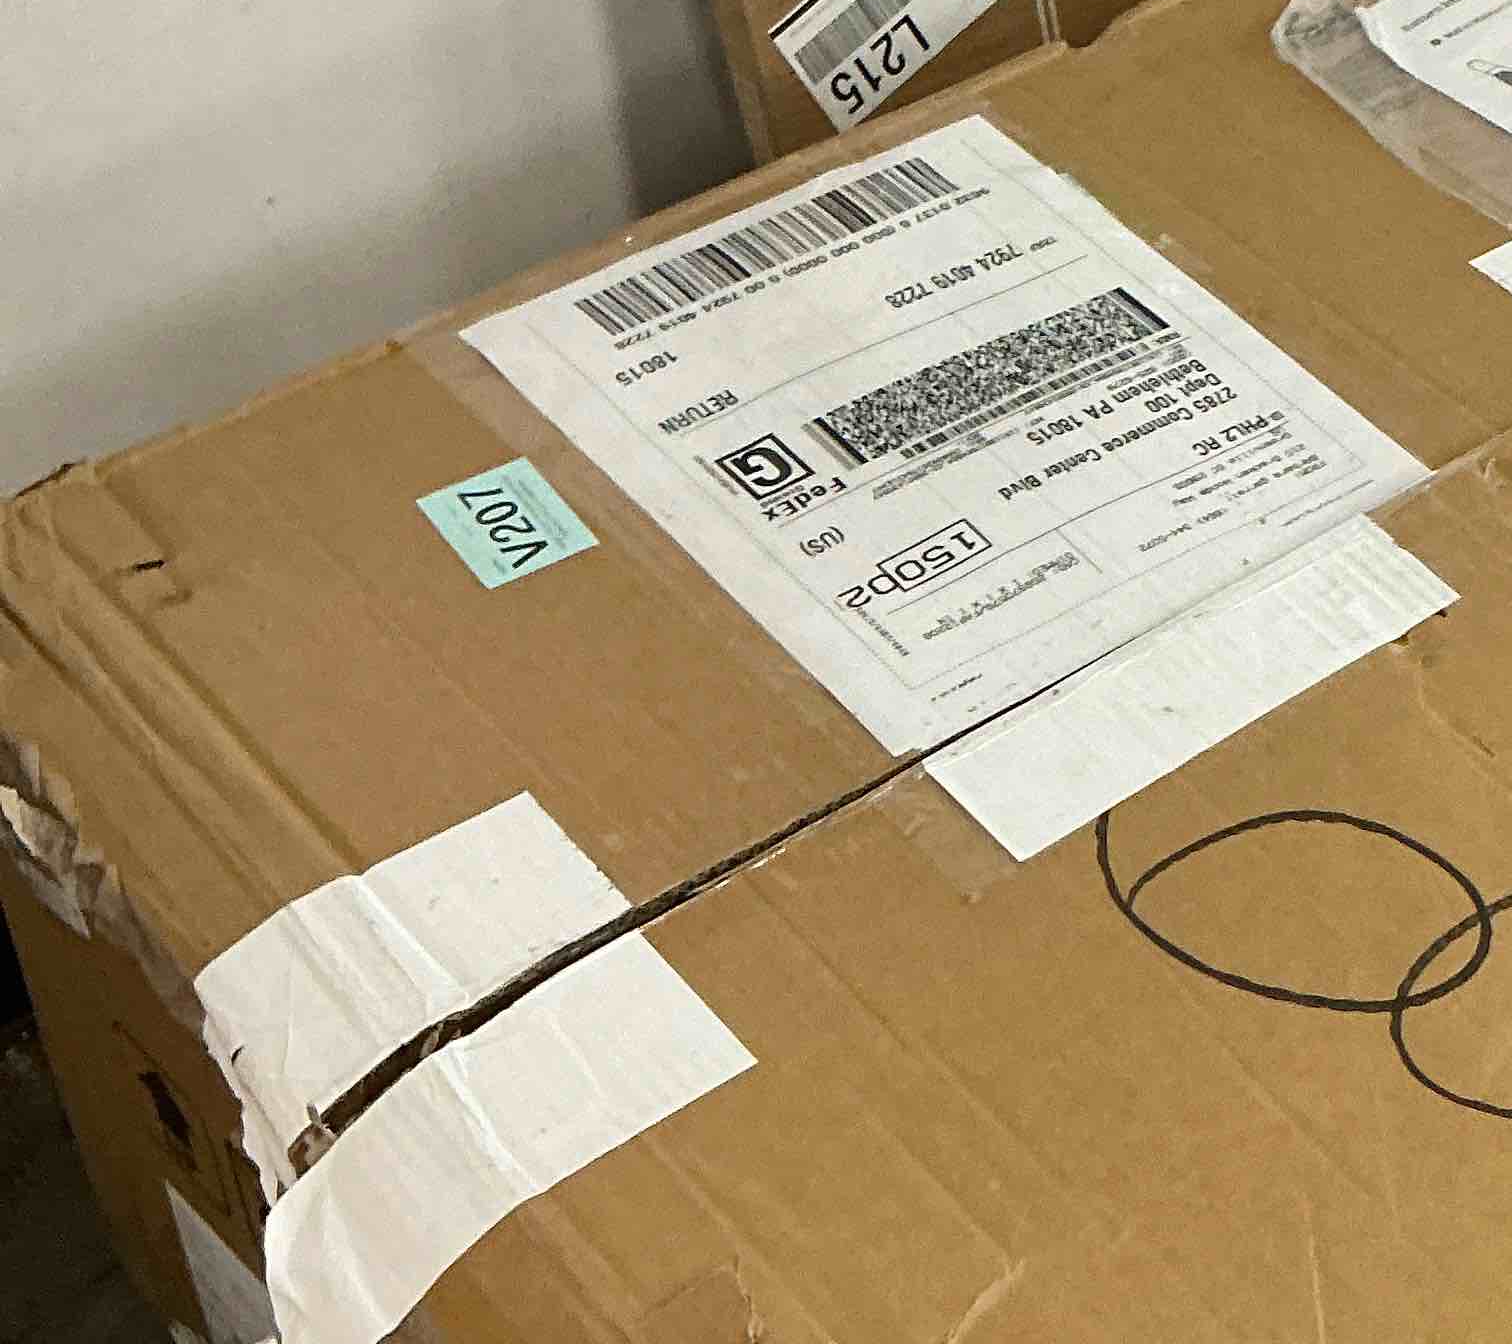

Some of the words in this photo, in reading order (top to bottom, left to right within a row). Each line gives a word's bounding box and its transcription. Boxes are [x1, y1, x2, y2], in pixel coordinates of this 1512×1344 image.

[830, 14, 930, 114] L215
[974, 243, 1024, 271] 7924
[884, 282, 934, 309] 7228
[615, 351, 678, 386] 18015
[1111, 359, 1208, 403] Bethlehem
[1176, 372, 1222, 398] Dept
[1192, 386, 1238, 413] 2785
[657, 389, 739, 434] RETURN
[1081, 399, 1115, 420] PA
[1144, 393, 1179, 413] 100
[1026, 415, 1084, 446] 18015
[1100, 407, 1194, 452] Commerce
[1218, 415, 1269, 443] PHL2
[1191, 436, 1222, 456] RC
[729, 447, 793, 487] G
[1043, 448, 1102, 479] Center
[761, 476, 848, 522] FedEx
[997, 474, 1043, 501] Blvd
[457, 487, 549, 570] V207
[799, 526, 845, 557] (US)
